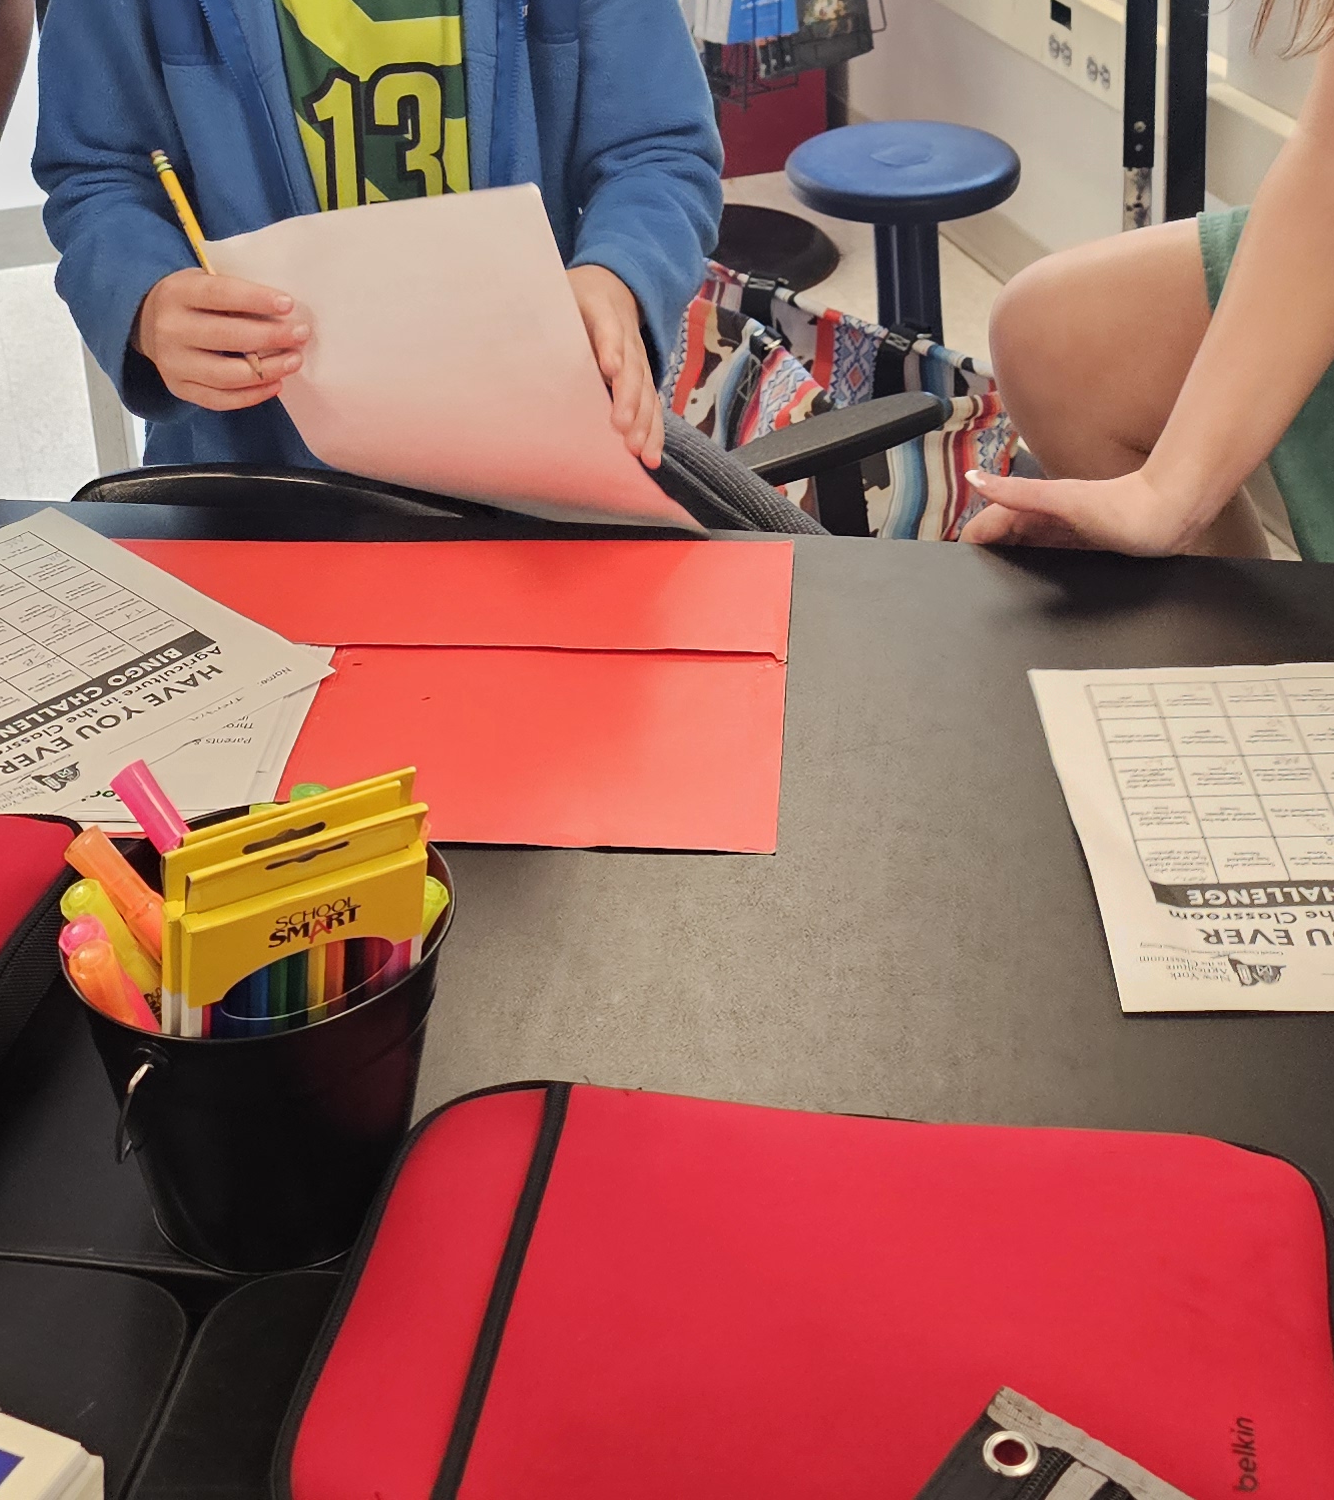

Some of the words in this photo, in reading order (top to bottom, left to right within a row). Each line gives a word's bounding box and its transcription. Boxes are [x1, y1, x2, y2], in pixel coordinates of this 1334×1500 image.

[302, 62, 448, 212] 13
[107, 647, 183, 687] BINGO
[124, 645, 221, 698] Agriculture
[104, 693, 125, 706] in
[143, 665, 223, 707] HAVE
[66, 705, 98, 722] the
[76, 703, 145, 741] YOU
[268, 905, 361, 948] SMART
[275, 897, 358, 928] SCHOOL
[1169, 910, 1298, 923] Classroom
[1202, 927, 1295, 947] EVER
[1170, 972, 1199, 981] York
[1203, 974, 1231, 982] New
[1232, 1416, 1259, 1492] belkin
